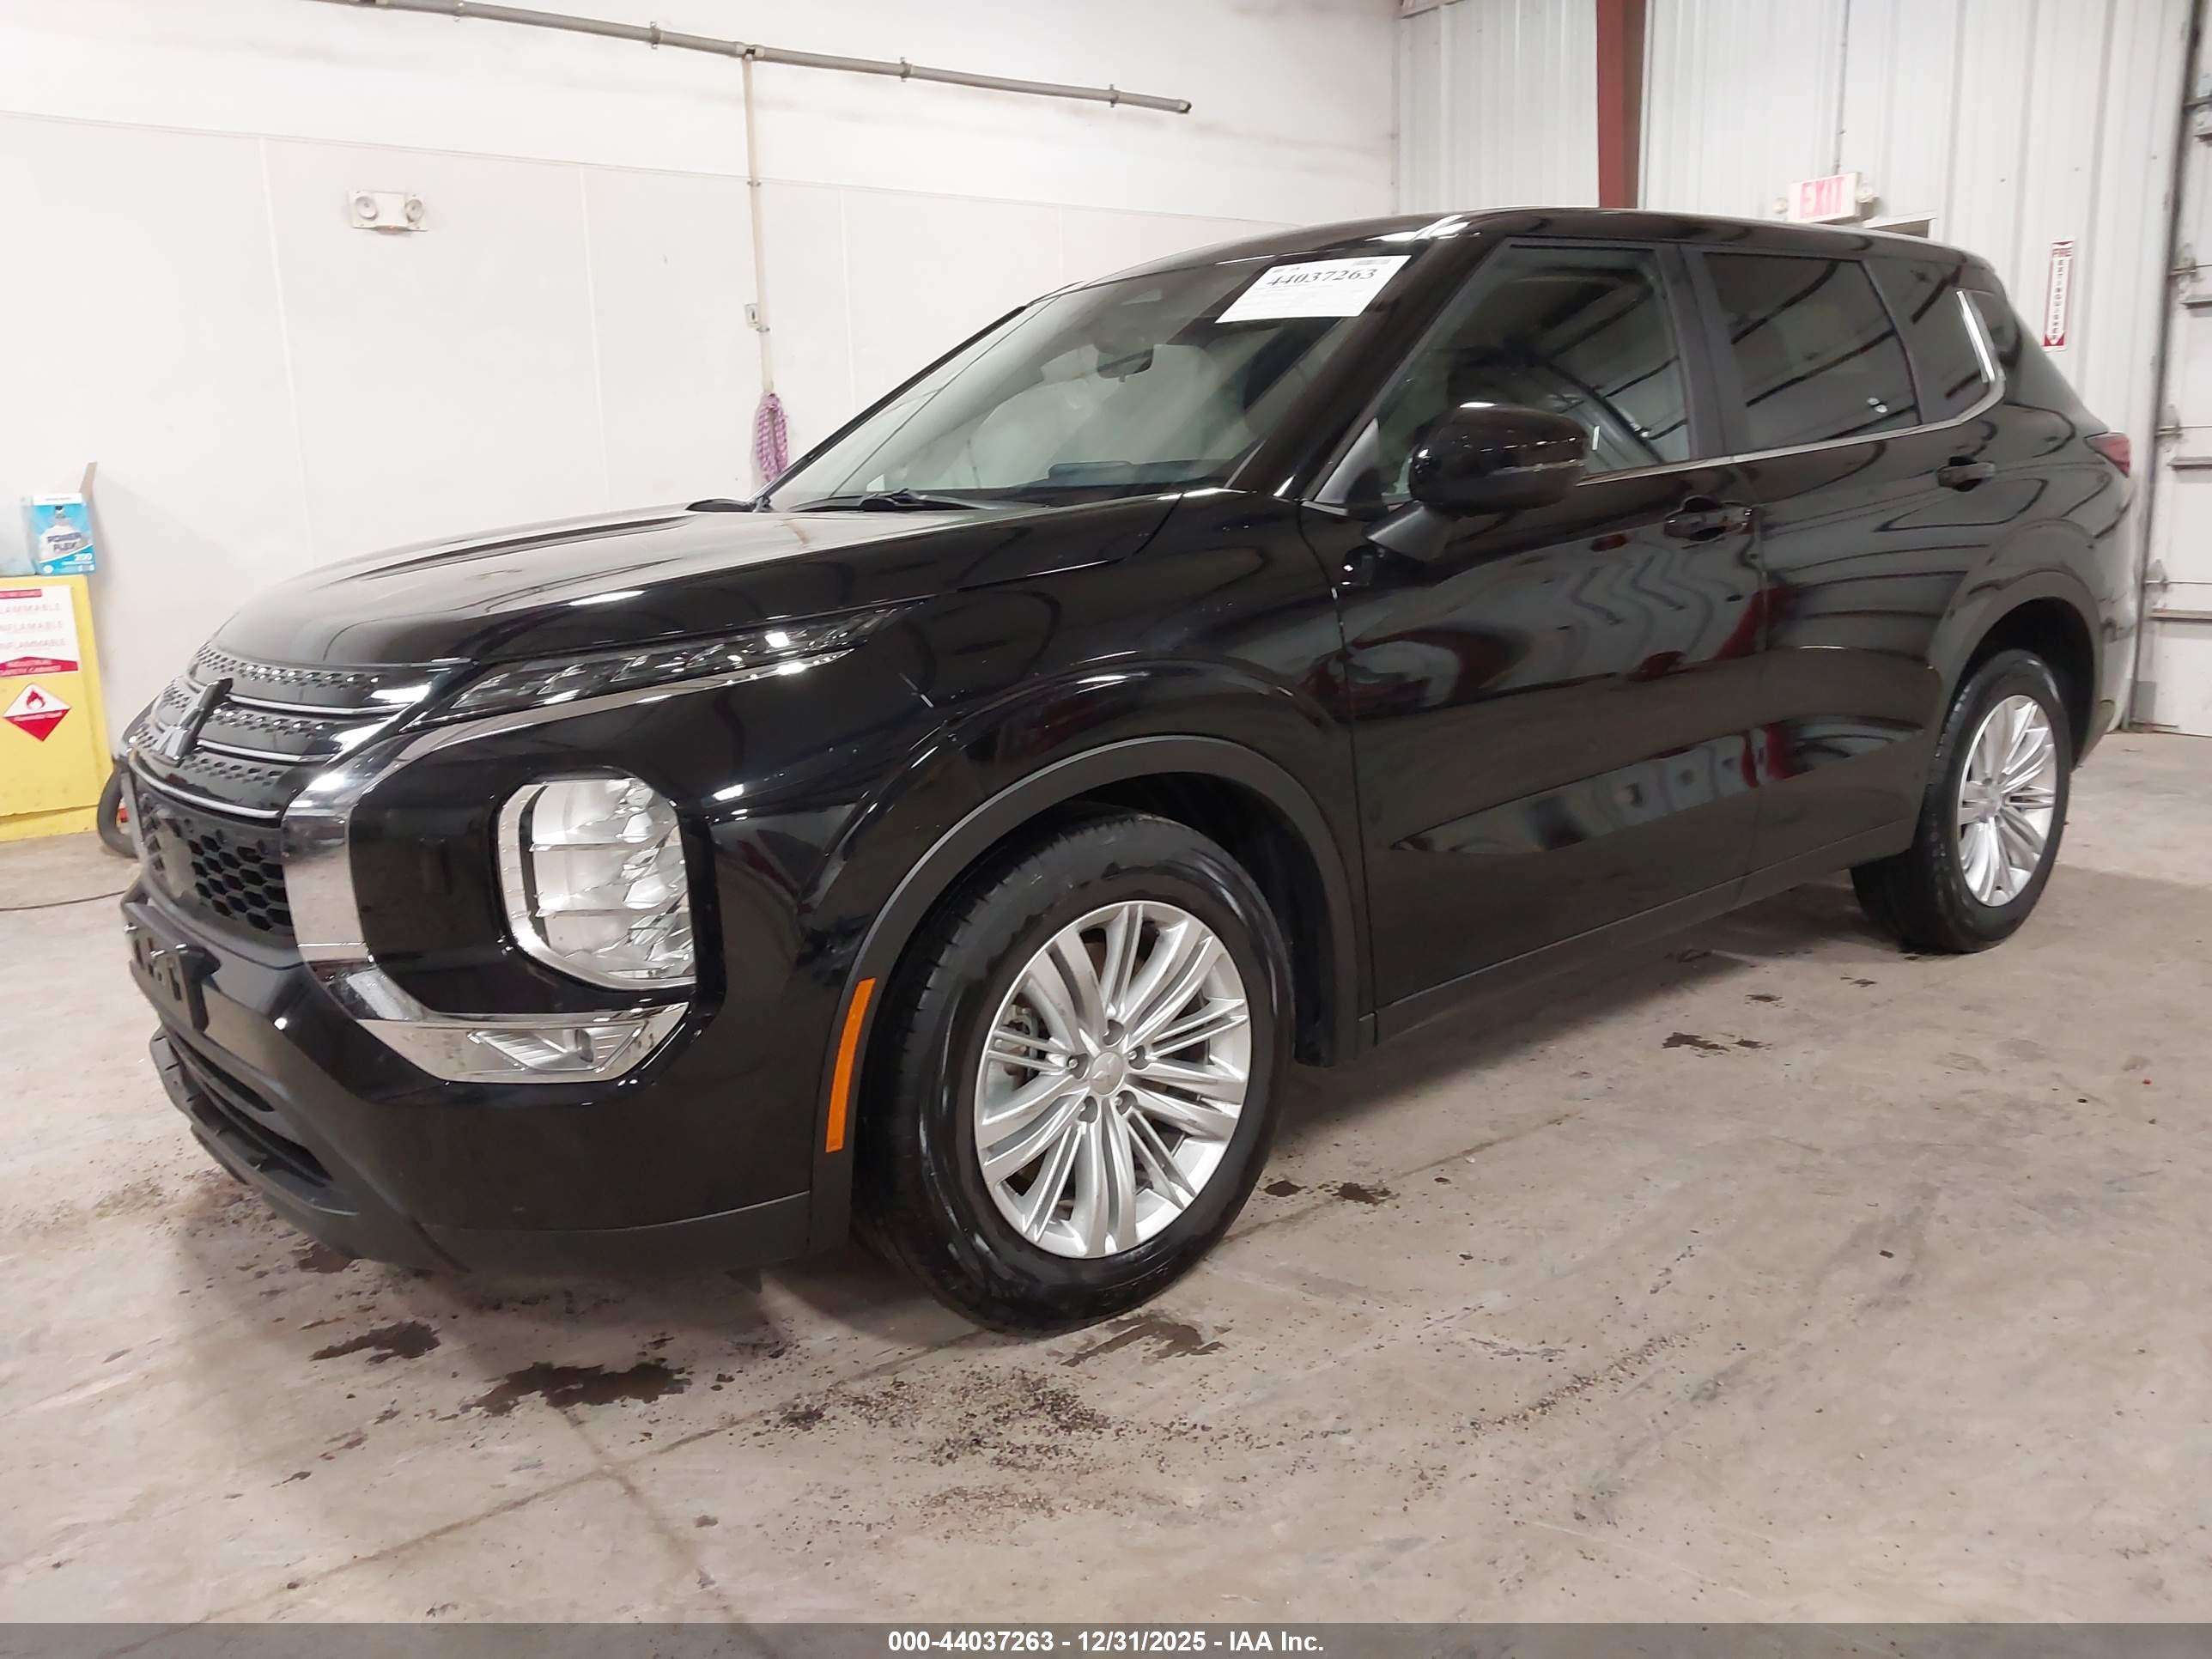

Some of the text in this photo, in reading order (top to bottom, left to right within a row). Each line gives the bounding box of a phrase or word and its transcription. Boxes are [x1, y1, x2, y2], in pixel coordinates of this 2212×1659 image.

[1800, 176, 1845, 218] EXIT
[1266, 269, 1378, 286] 44037263
[0, 603, 61, 613] LAMMABLE
